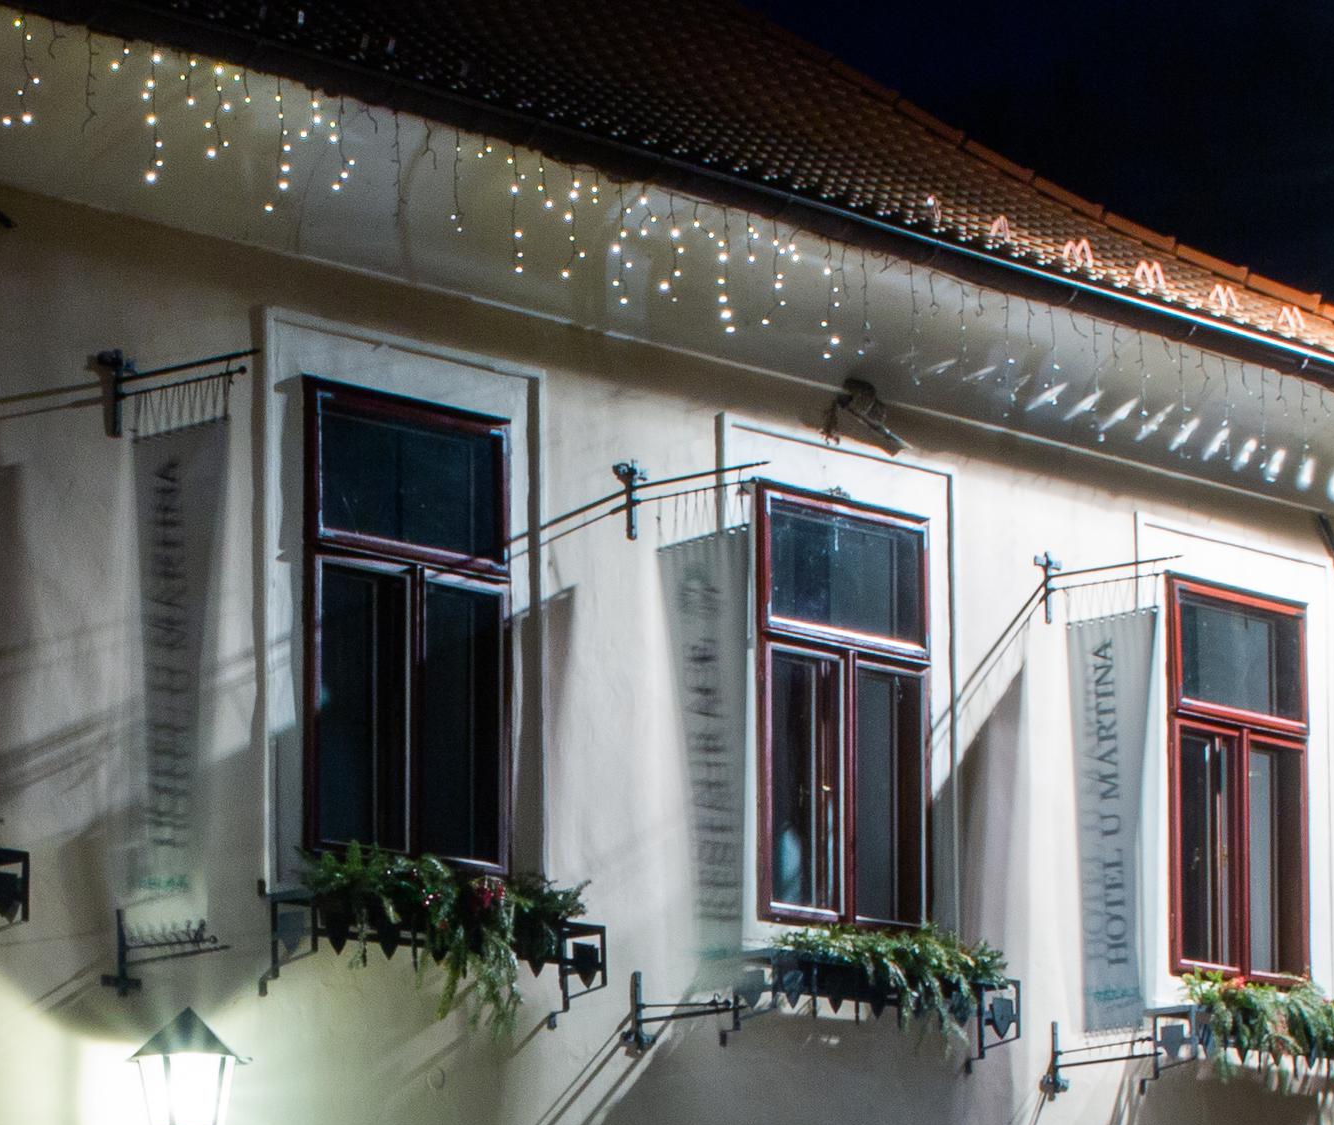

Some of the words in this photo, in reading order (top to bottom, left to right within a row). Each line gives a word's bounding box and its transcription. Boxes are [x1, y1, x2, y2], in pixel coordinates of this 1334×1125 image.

[1091, 638, 1120, 801] MARTINA
[1101, 812, 1122, 839] U
[1103, 849, 1129, 966] HOTEL
